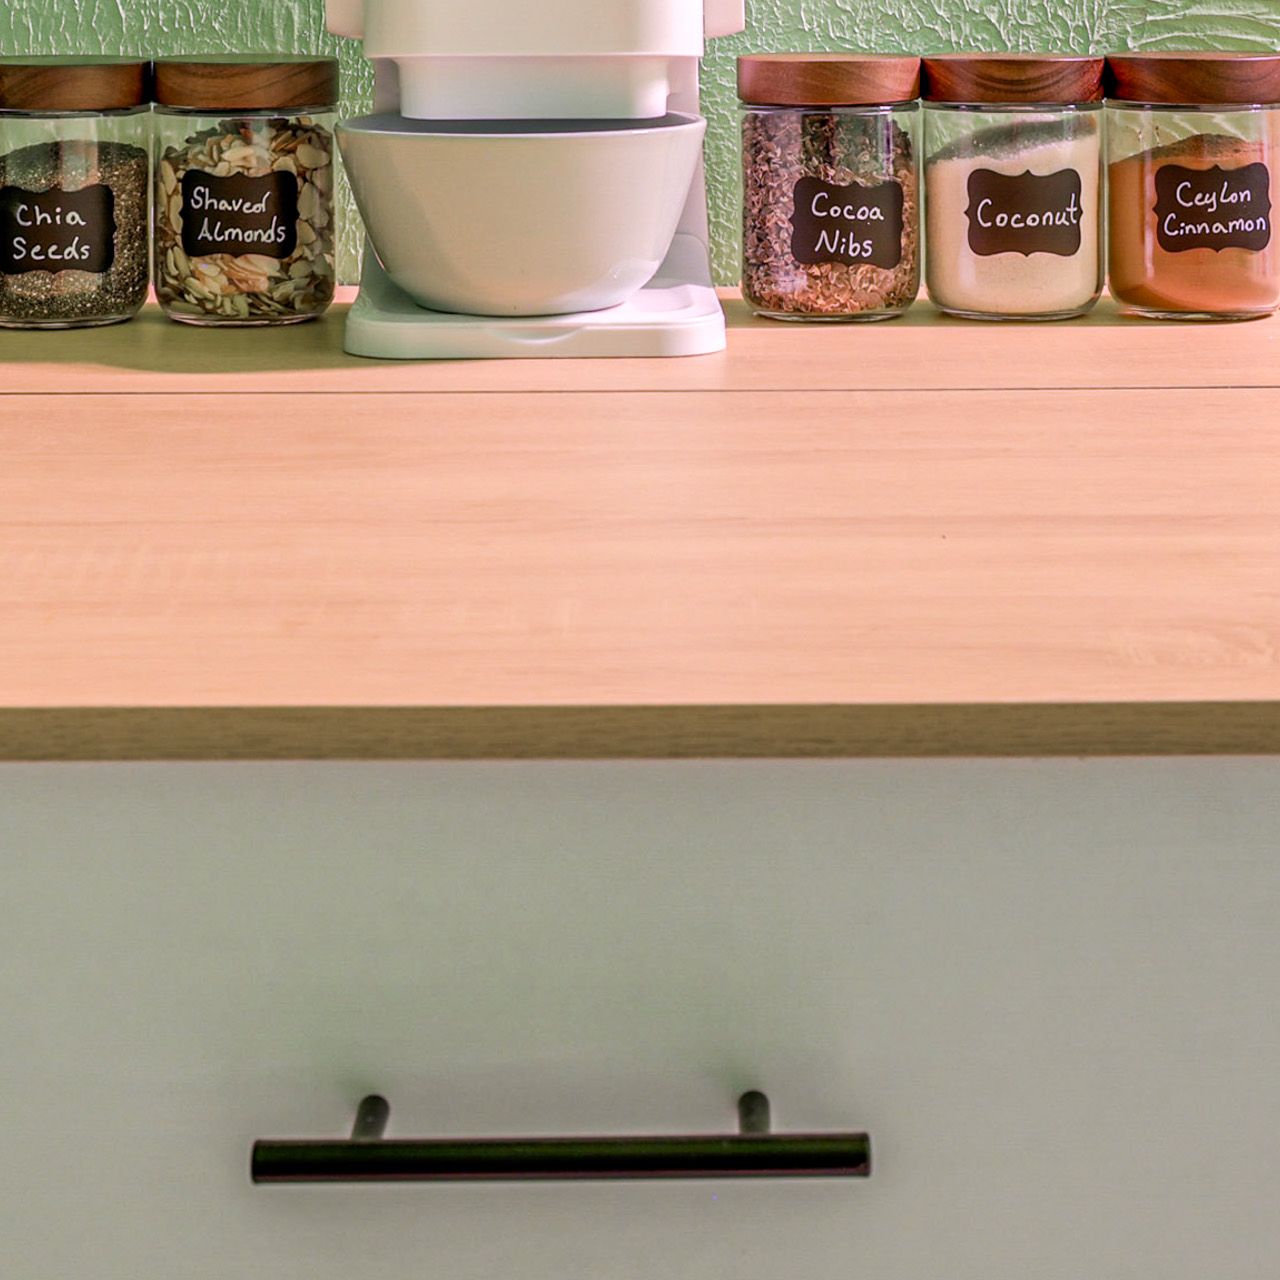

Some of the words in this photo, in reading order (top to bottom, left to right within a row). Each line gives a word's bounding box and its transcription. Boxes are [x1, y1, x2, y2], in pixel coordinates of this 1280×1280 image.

[191, 186, 271, 214] Shaved
[811, 192, 884, 221] Cocoa
[977, 192, 1078, 228] Coconut
[1176, 181, 1252, 212] Ceylon
[16, 204, 87, 226] Chia
[198, 215, 286, 243] Almonds
[1164, 213, 1266, 236] Cinnamon
[12, 236, 91, 260] Seeds
[814, 229, 873, 257] Nibs
